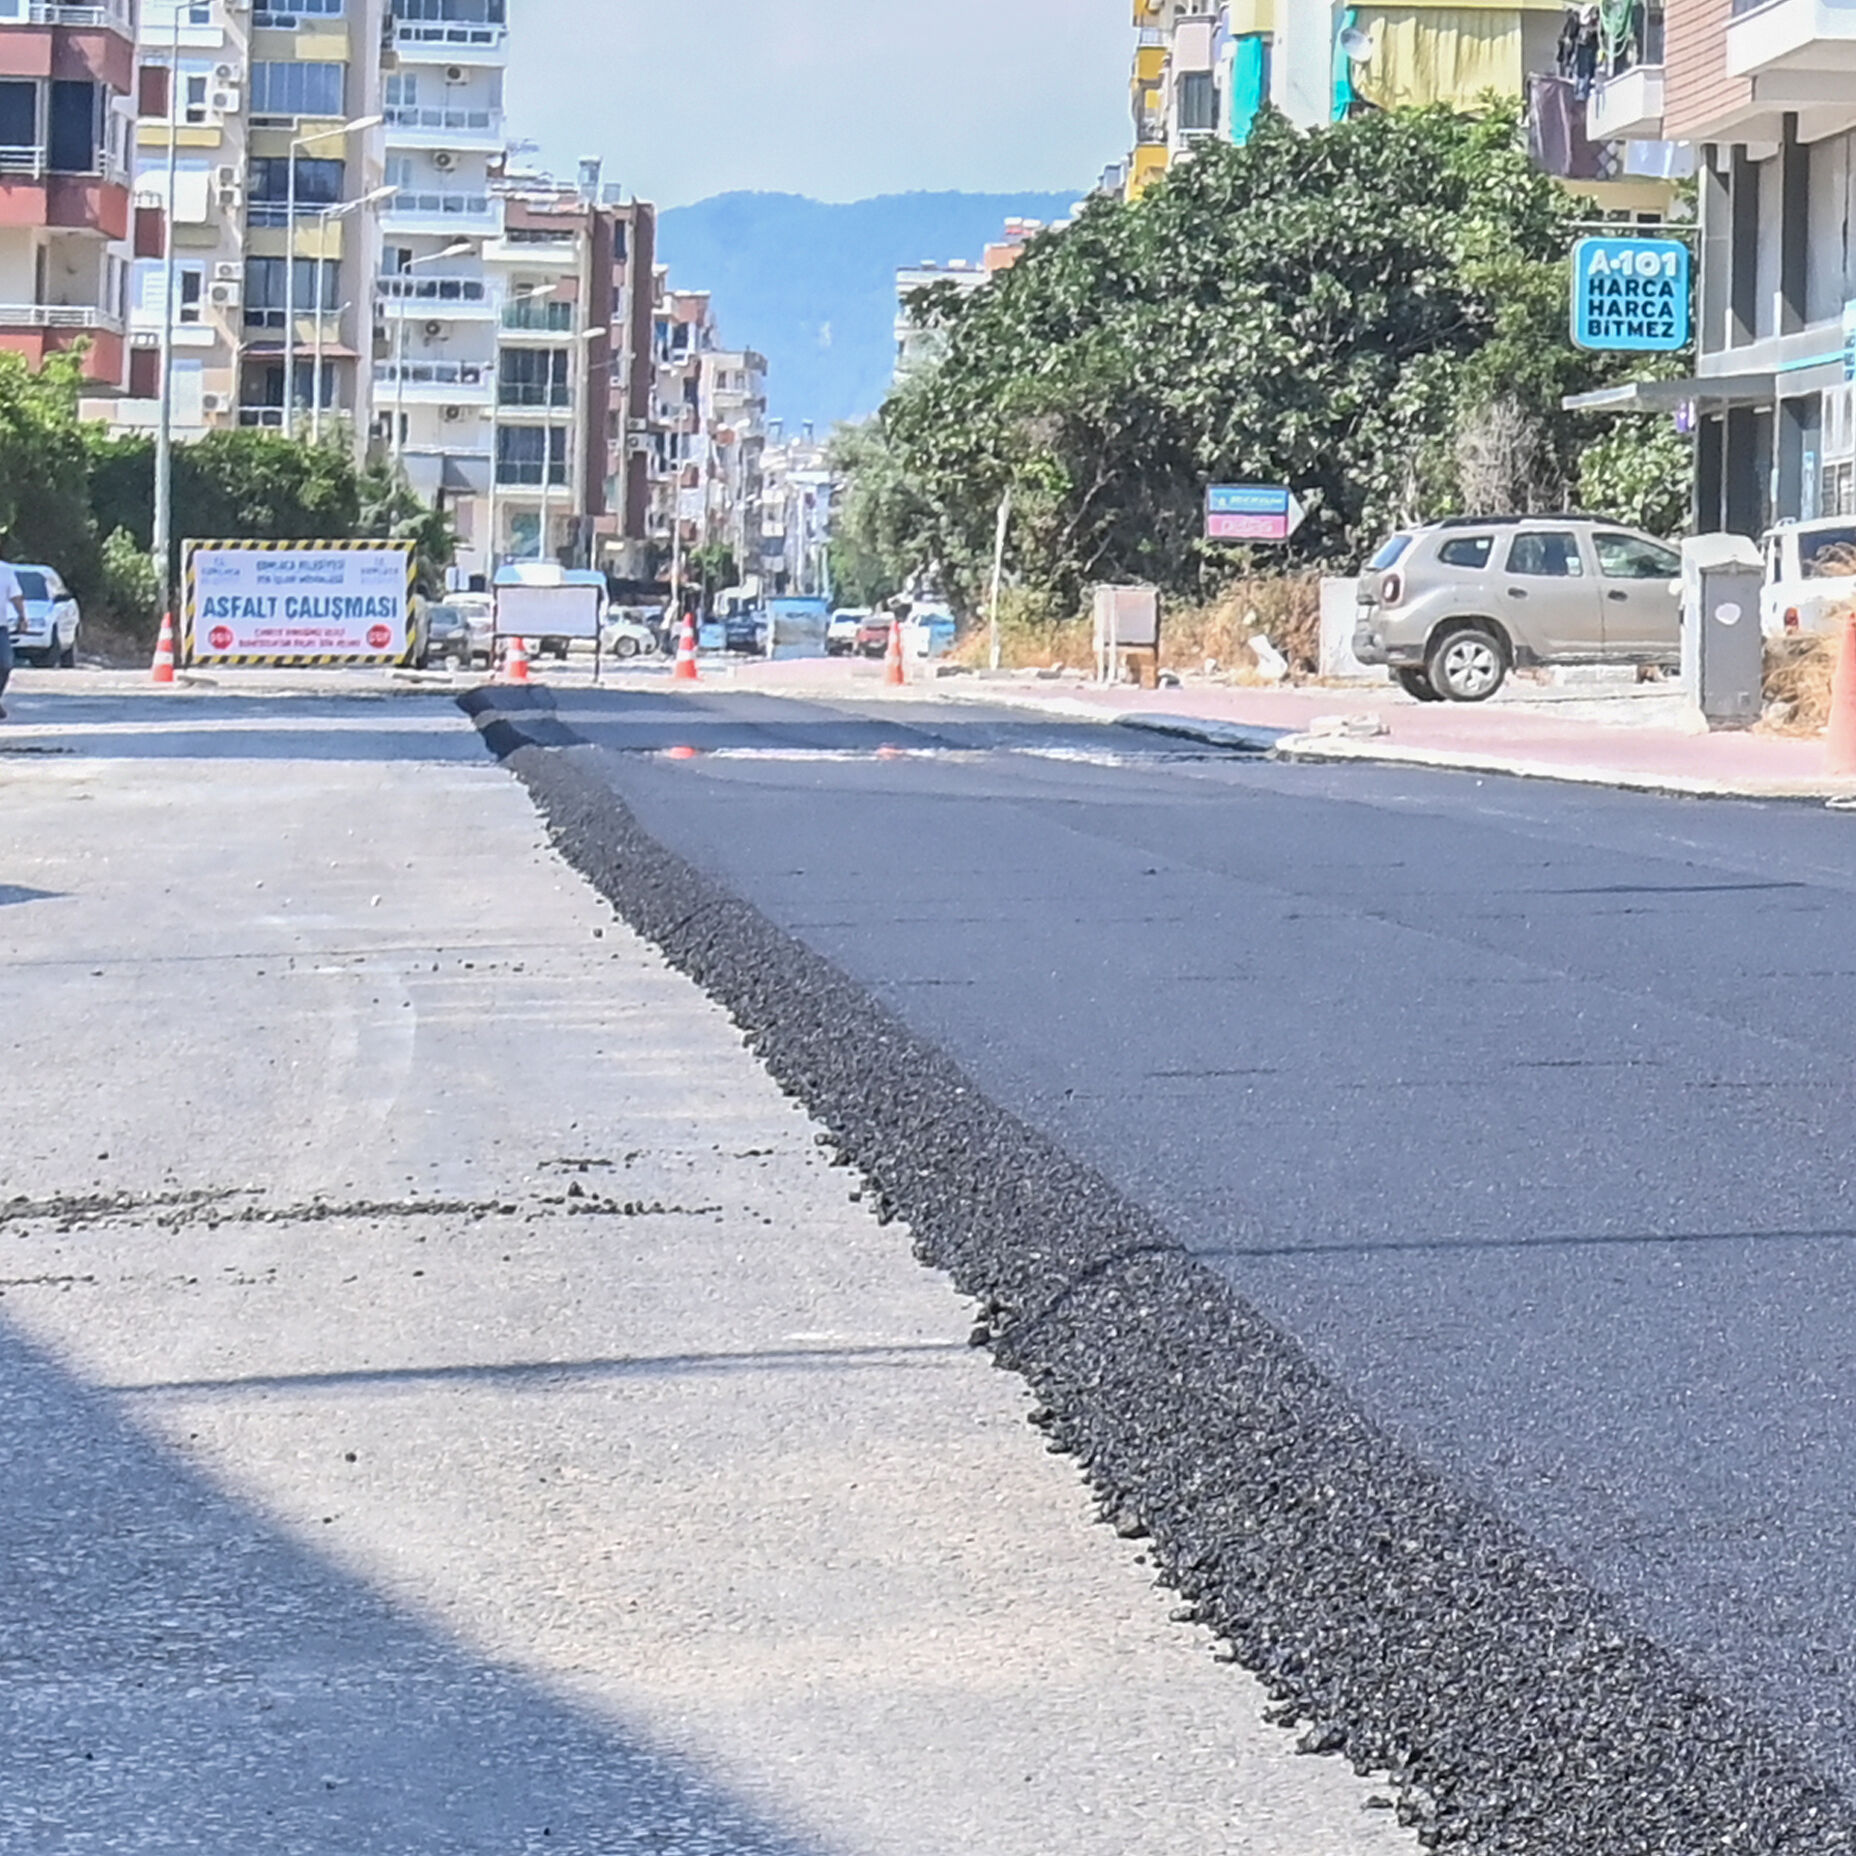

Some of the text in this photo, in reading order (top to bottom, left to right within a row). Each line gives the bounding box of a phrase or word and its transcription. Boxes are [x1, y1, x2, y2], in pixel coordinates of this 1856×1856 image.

[1587, 277, 1675, 298] HARCA
[1587, 298, 1674, 318] HARCA
[1586, 318, 1675, 338] BİTMEZ
[202, 595, 278, 619] ASFALT
